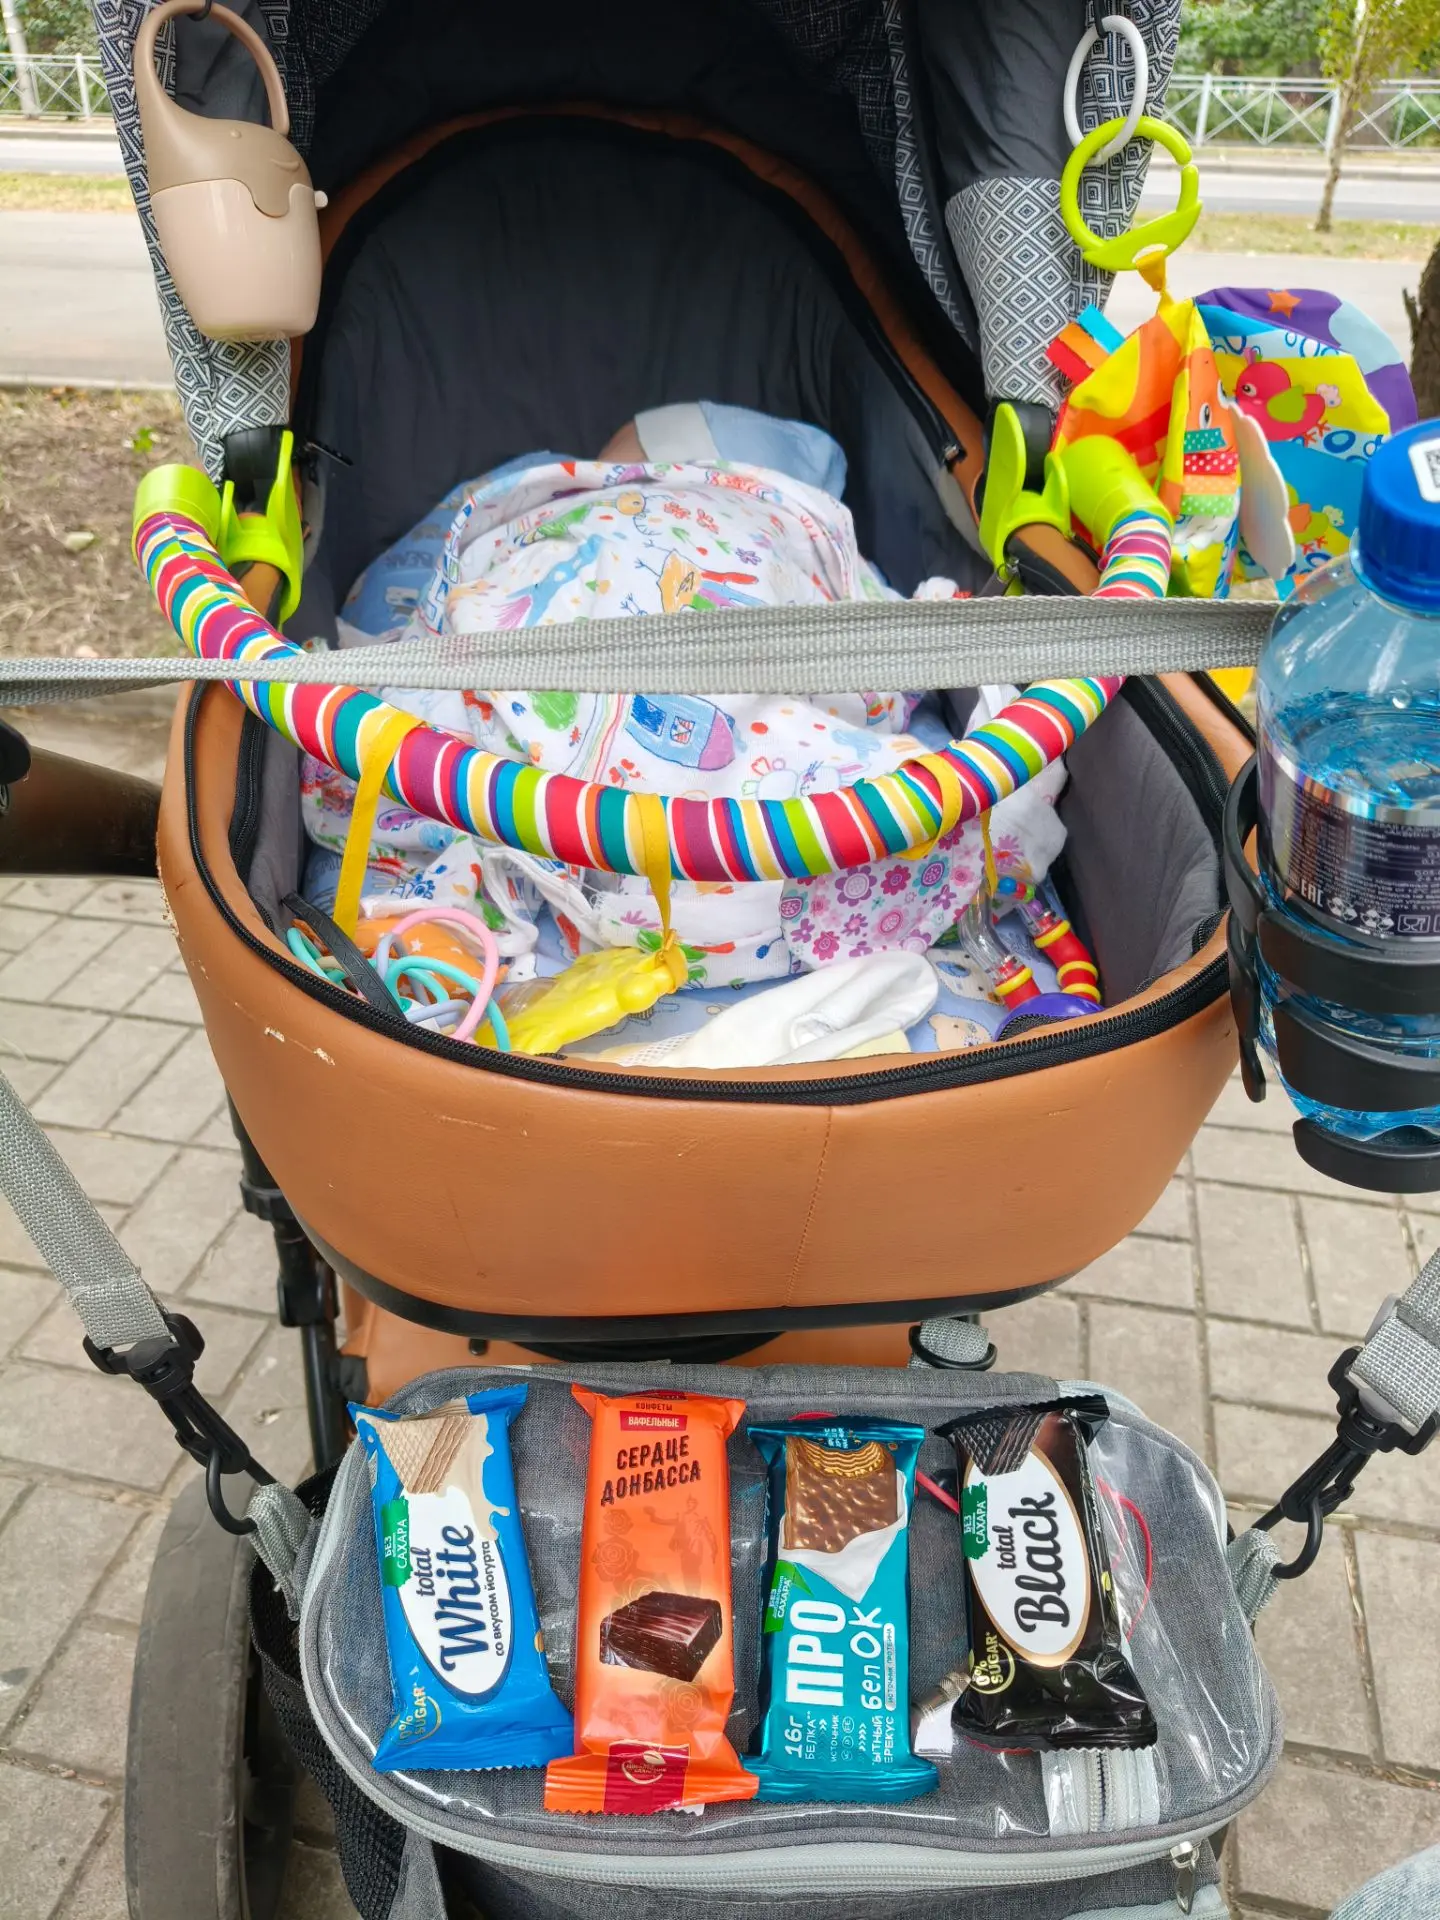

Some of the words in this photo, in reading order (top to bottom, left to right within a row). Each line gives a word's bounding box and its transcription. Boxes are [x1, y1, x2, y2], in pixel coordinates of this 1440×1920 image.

[628, 1416, 680, 1428] ВАФЕЛЬНЫЕ
[636, 1402, 673, 1411] КОНФЕТЫ
[616, 1435, 690, 1470] СЕРДЦЕ
[600, 1460, 701, 1507] ДОНБАССА
[384, 1535, 393, 1558] БЕЗ
[397, 1518, 408, 1569] САХАРА
[963, 1514, 972, 1535] БЕЗ
[992, 1525, 1017, 1570] total
[410, 1546, 435, 1597] total
[481, 1541, 496, 1590] йогурта
[1007, 1491, 1070, 1633] Black
[435, 1524, 489, 1673] White
[487, 1593, 503, 1640] вкусом
[493, 1642, 505, 1657] со
[785, 1600, 846, 1708] ПРО
[973, 1660, 991, 1687] 0%
[872, 1715, 884, 1766] ЫТНЫЙ
